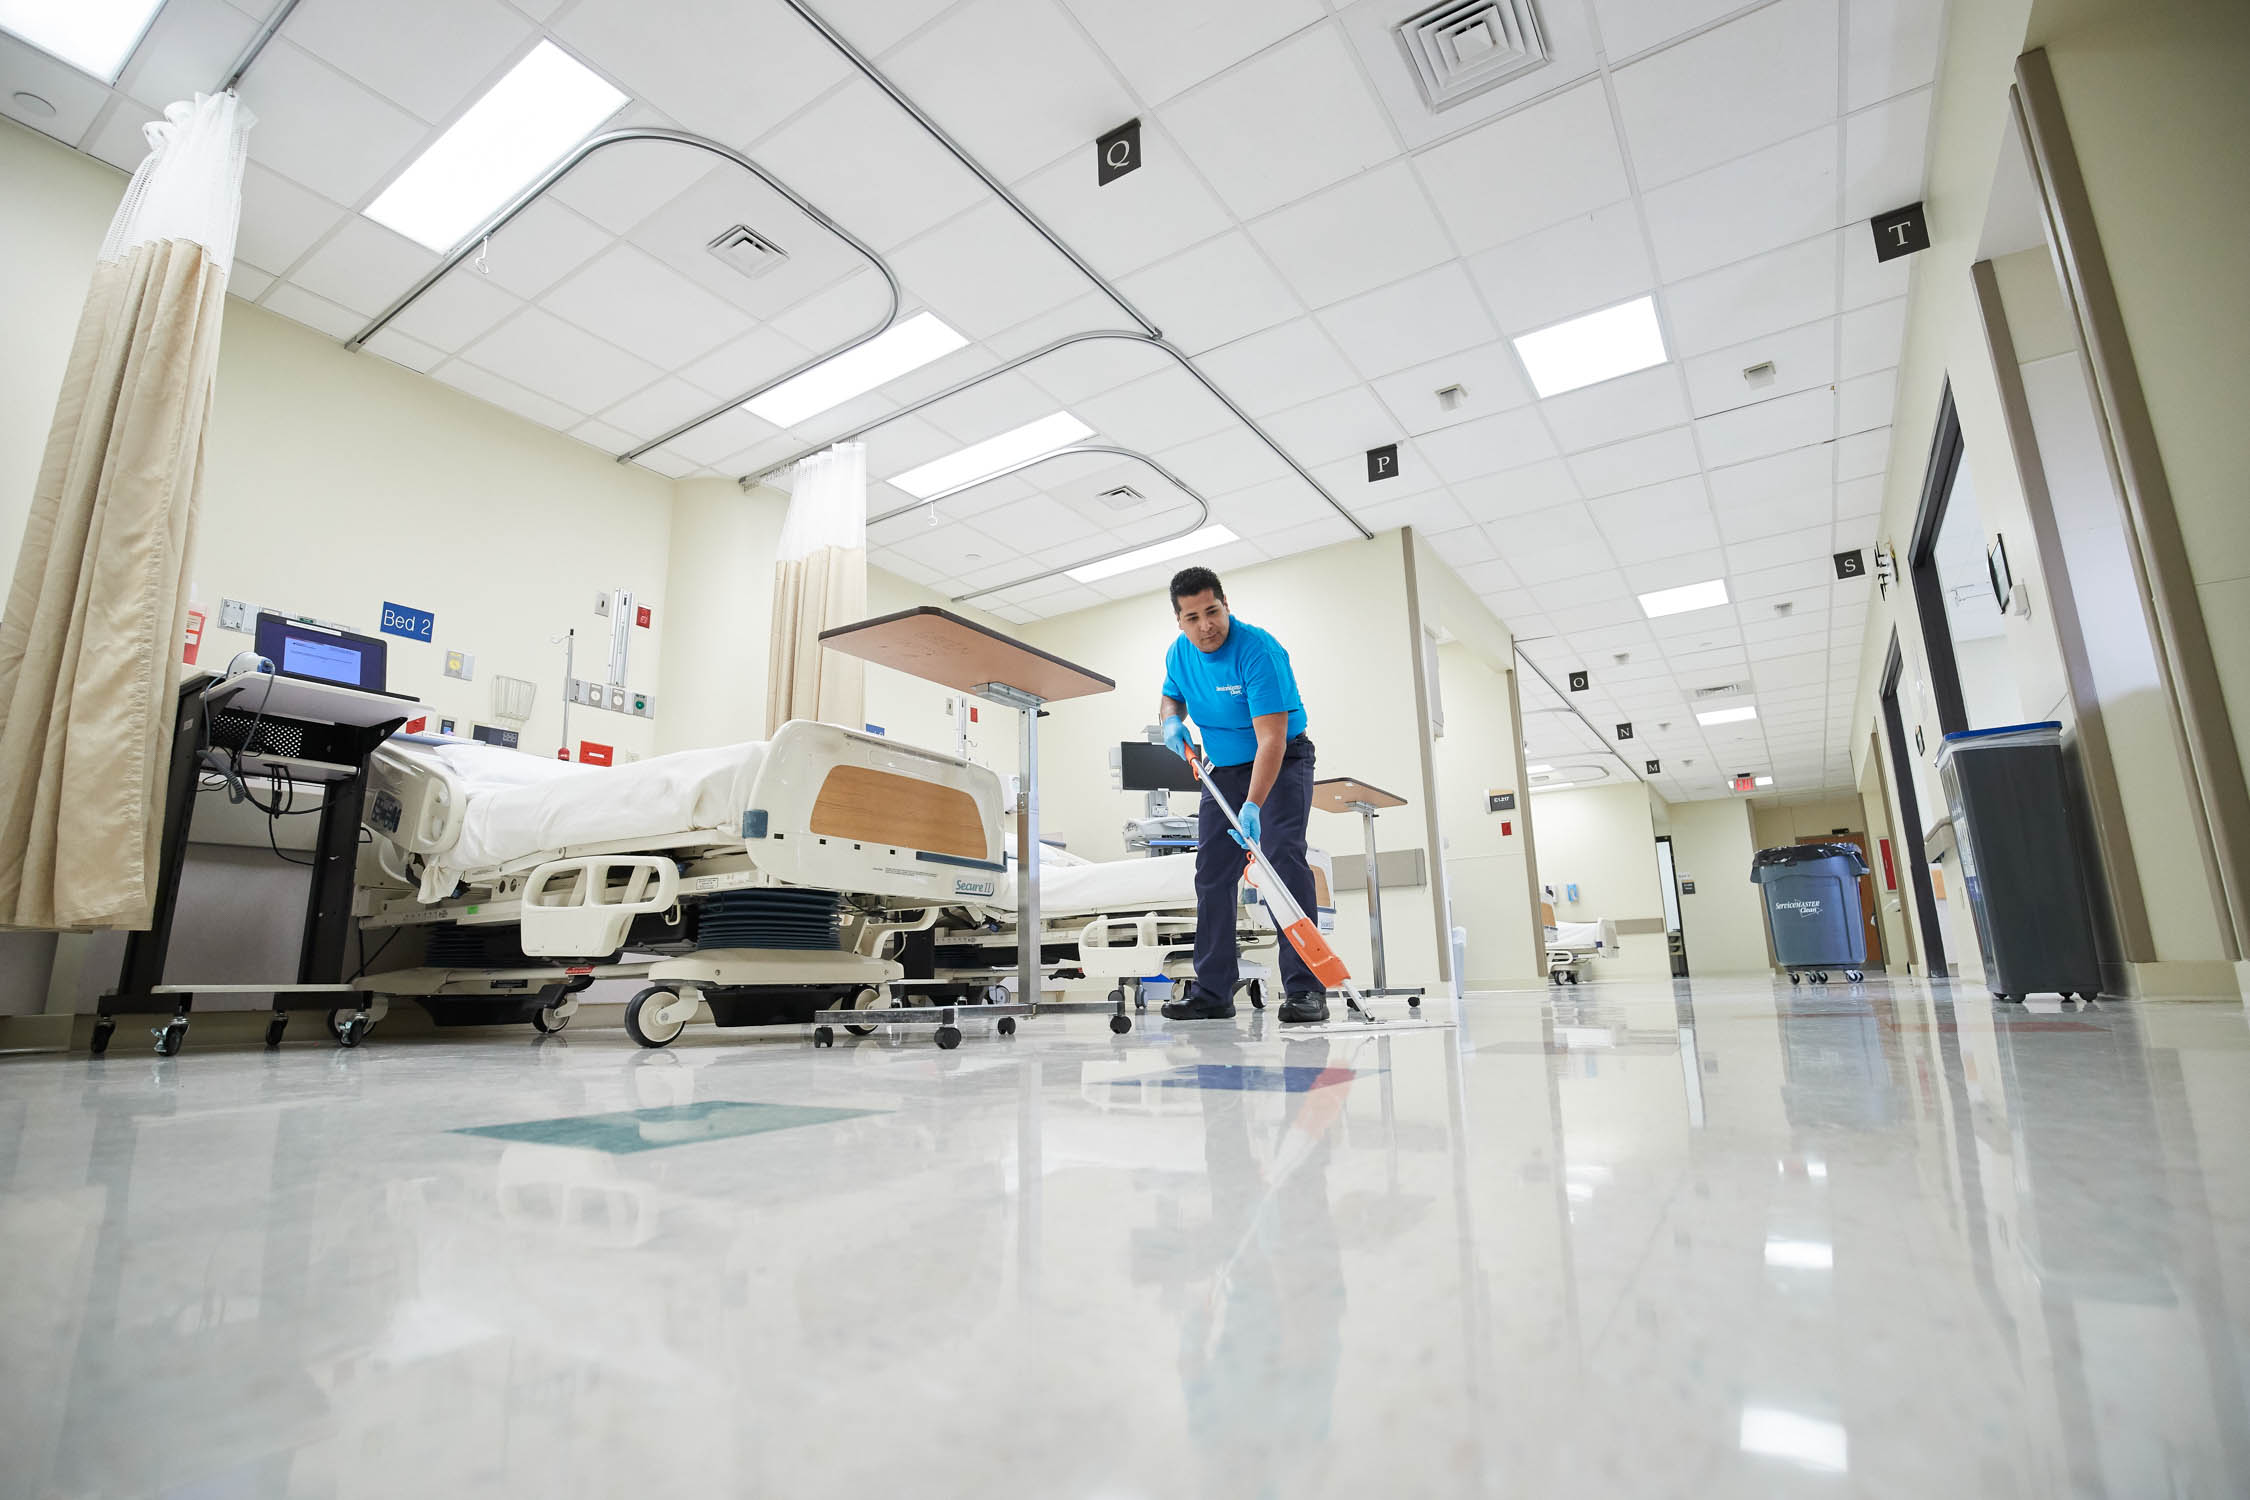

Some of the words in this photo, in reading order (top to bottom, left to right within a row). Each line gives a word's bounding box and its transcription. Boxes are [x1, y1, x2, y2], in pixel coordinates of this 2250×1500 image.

[1106, 140, 1130, 170] Q
[1888, 221, 1911, 247] T
[1377, 456, 1390, 474] P
[1844, 558, 1856, 573] S
[383, 609, 416, 632] Bed
[421, 618, 431, 636] 2
[1573, 677, 1585, 688] O
[1620, 728, 1630, 737] N
[1648, 764, 1658, 772] M
[955, 880, 984, 892] Secure
